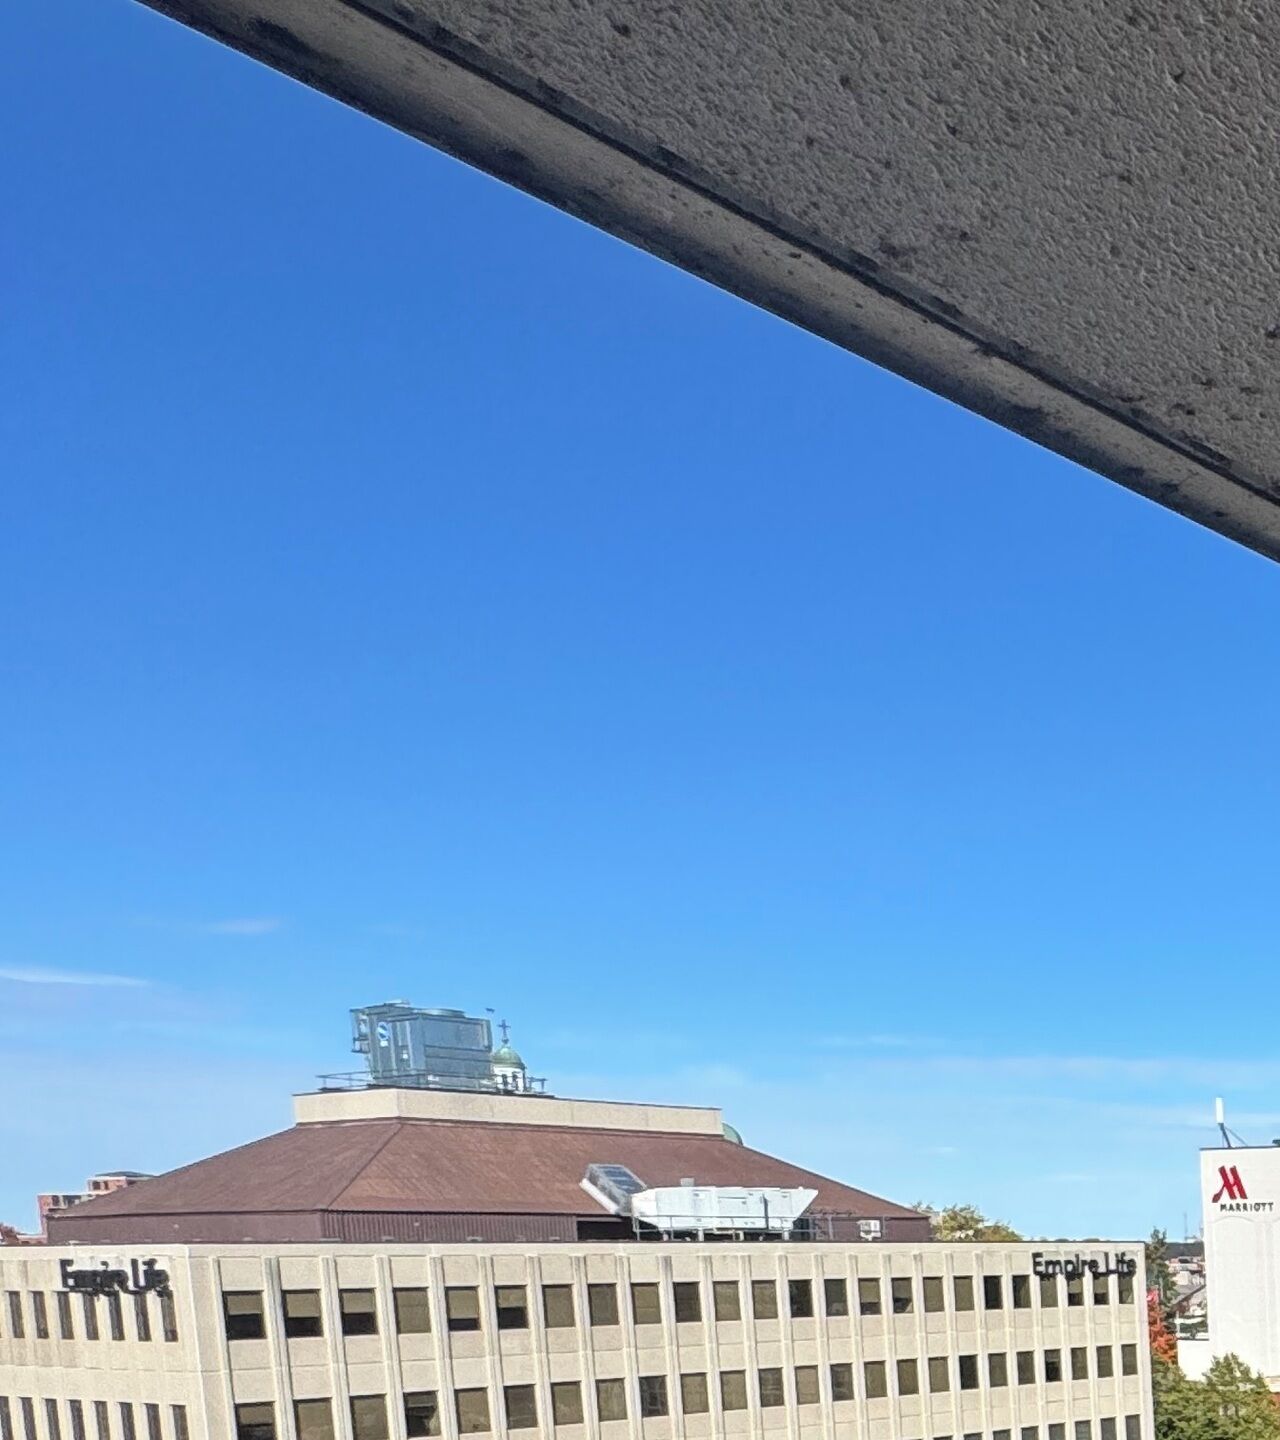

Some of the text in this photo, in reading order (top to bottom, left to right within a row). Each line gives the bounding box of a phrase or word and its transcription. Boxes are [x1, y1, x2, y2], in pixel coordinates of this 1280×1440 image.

[1220, 1202, 1274, 1212] MARRIOTT
[1031, 1251, 1137, 1281] Empire Life
